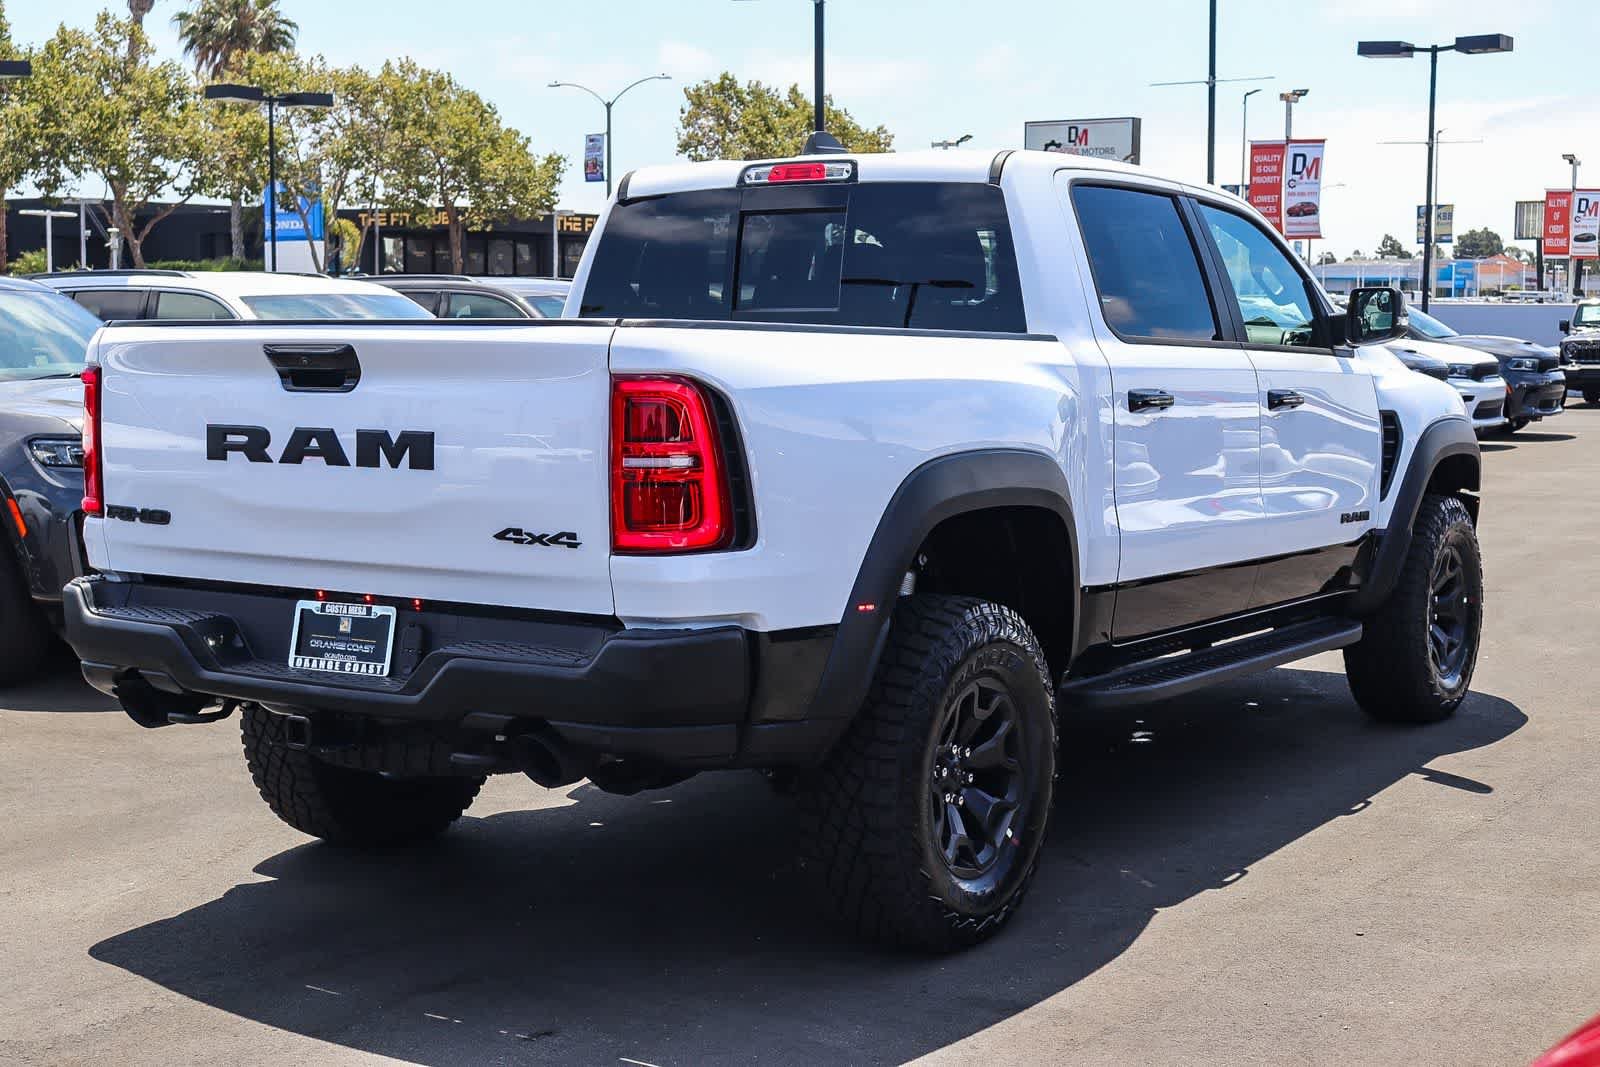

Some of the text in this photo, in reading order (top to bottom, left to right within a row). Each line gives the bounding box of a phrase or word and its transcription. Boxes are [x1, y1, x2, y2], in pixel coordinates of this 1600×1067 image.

[1081, 147, 1116, 156] MOTORS
[1253, 154, 1281, 163] QUALITY
[1263, 165, 1278, 173] OUR
[1252, 176, 1281, 184] PRIORITY
[1253, 195, 1279, 203] LOWEST
[358, 213, 387, 226] THE
[415, 211, 450, 225] CUB
[556, 215, 582, 231] THE
[206, 424, 435, 471] RAM
[1340, 511, 1370, 524] RAM
[325, 603, 367, 615] COSTA MESA
[310, 639, 375, 653] ORANGE COAST
[295, 657, 383, 675] ORANGE COAST
